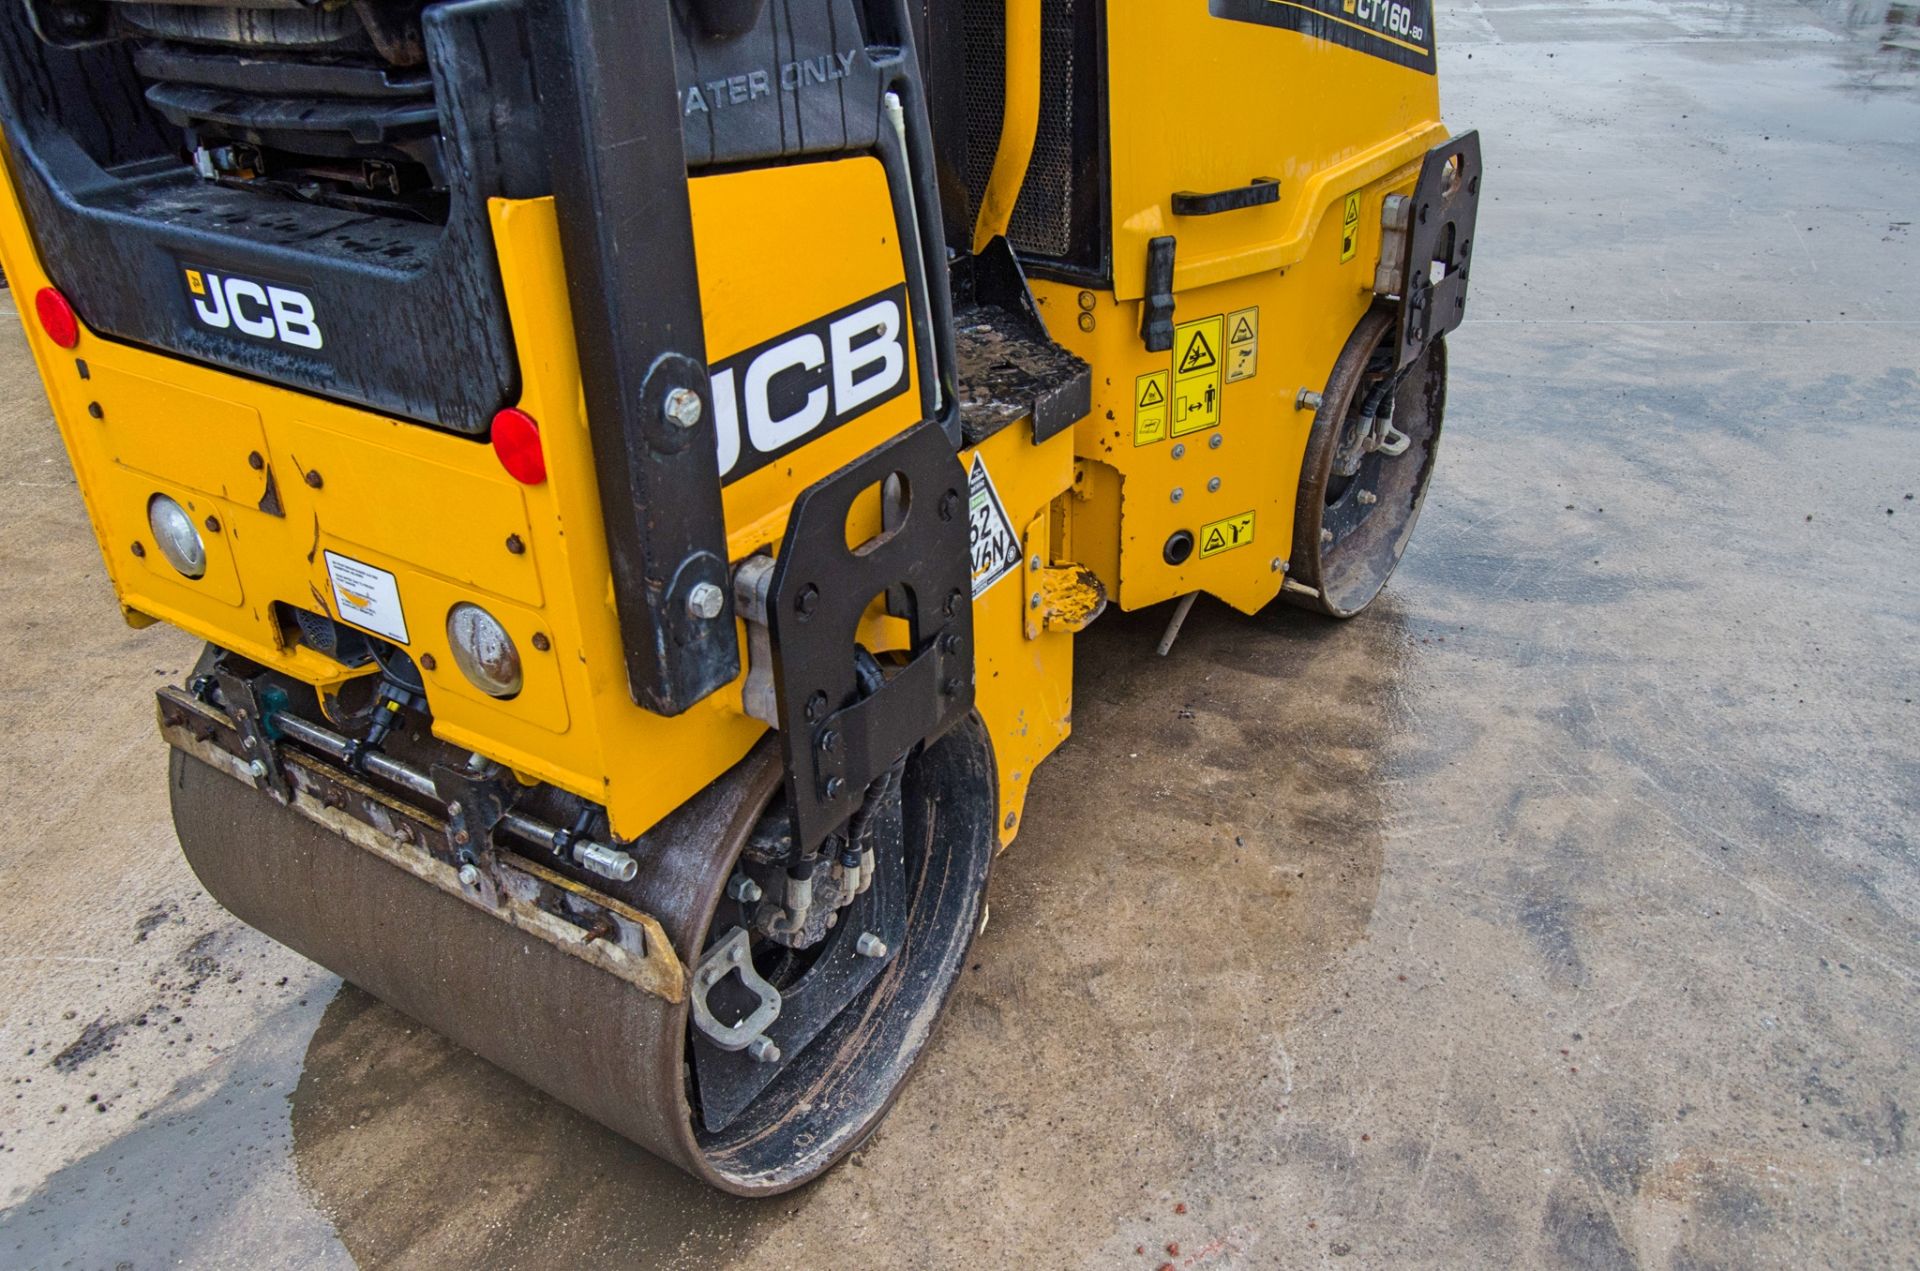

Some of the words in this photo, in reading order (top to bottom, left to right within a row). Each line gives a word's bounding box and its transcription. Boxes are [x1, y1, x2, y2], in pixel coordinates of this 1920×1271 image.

[679, 70, 770, 117] ATER
[781, 49, 857, 91] ONLY
[193, 273, 323, 350] JCB
